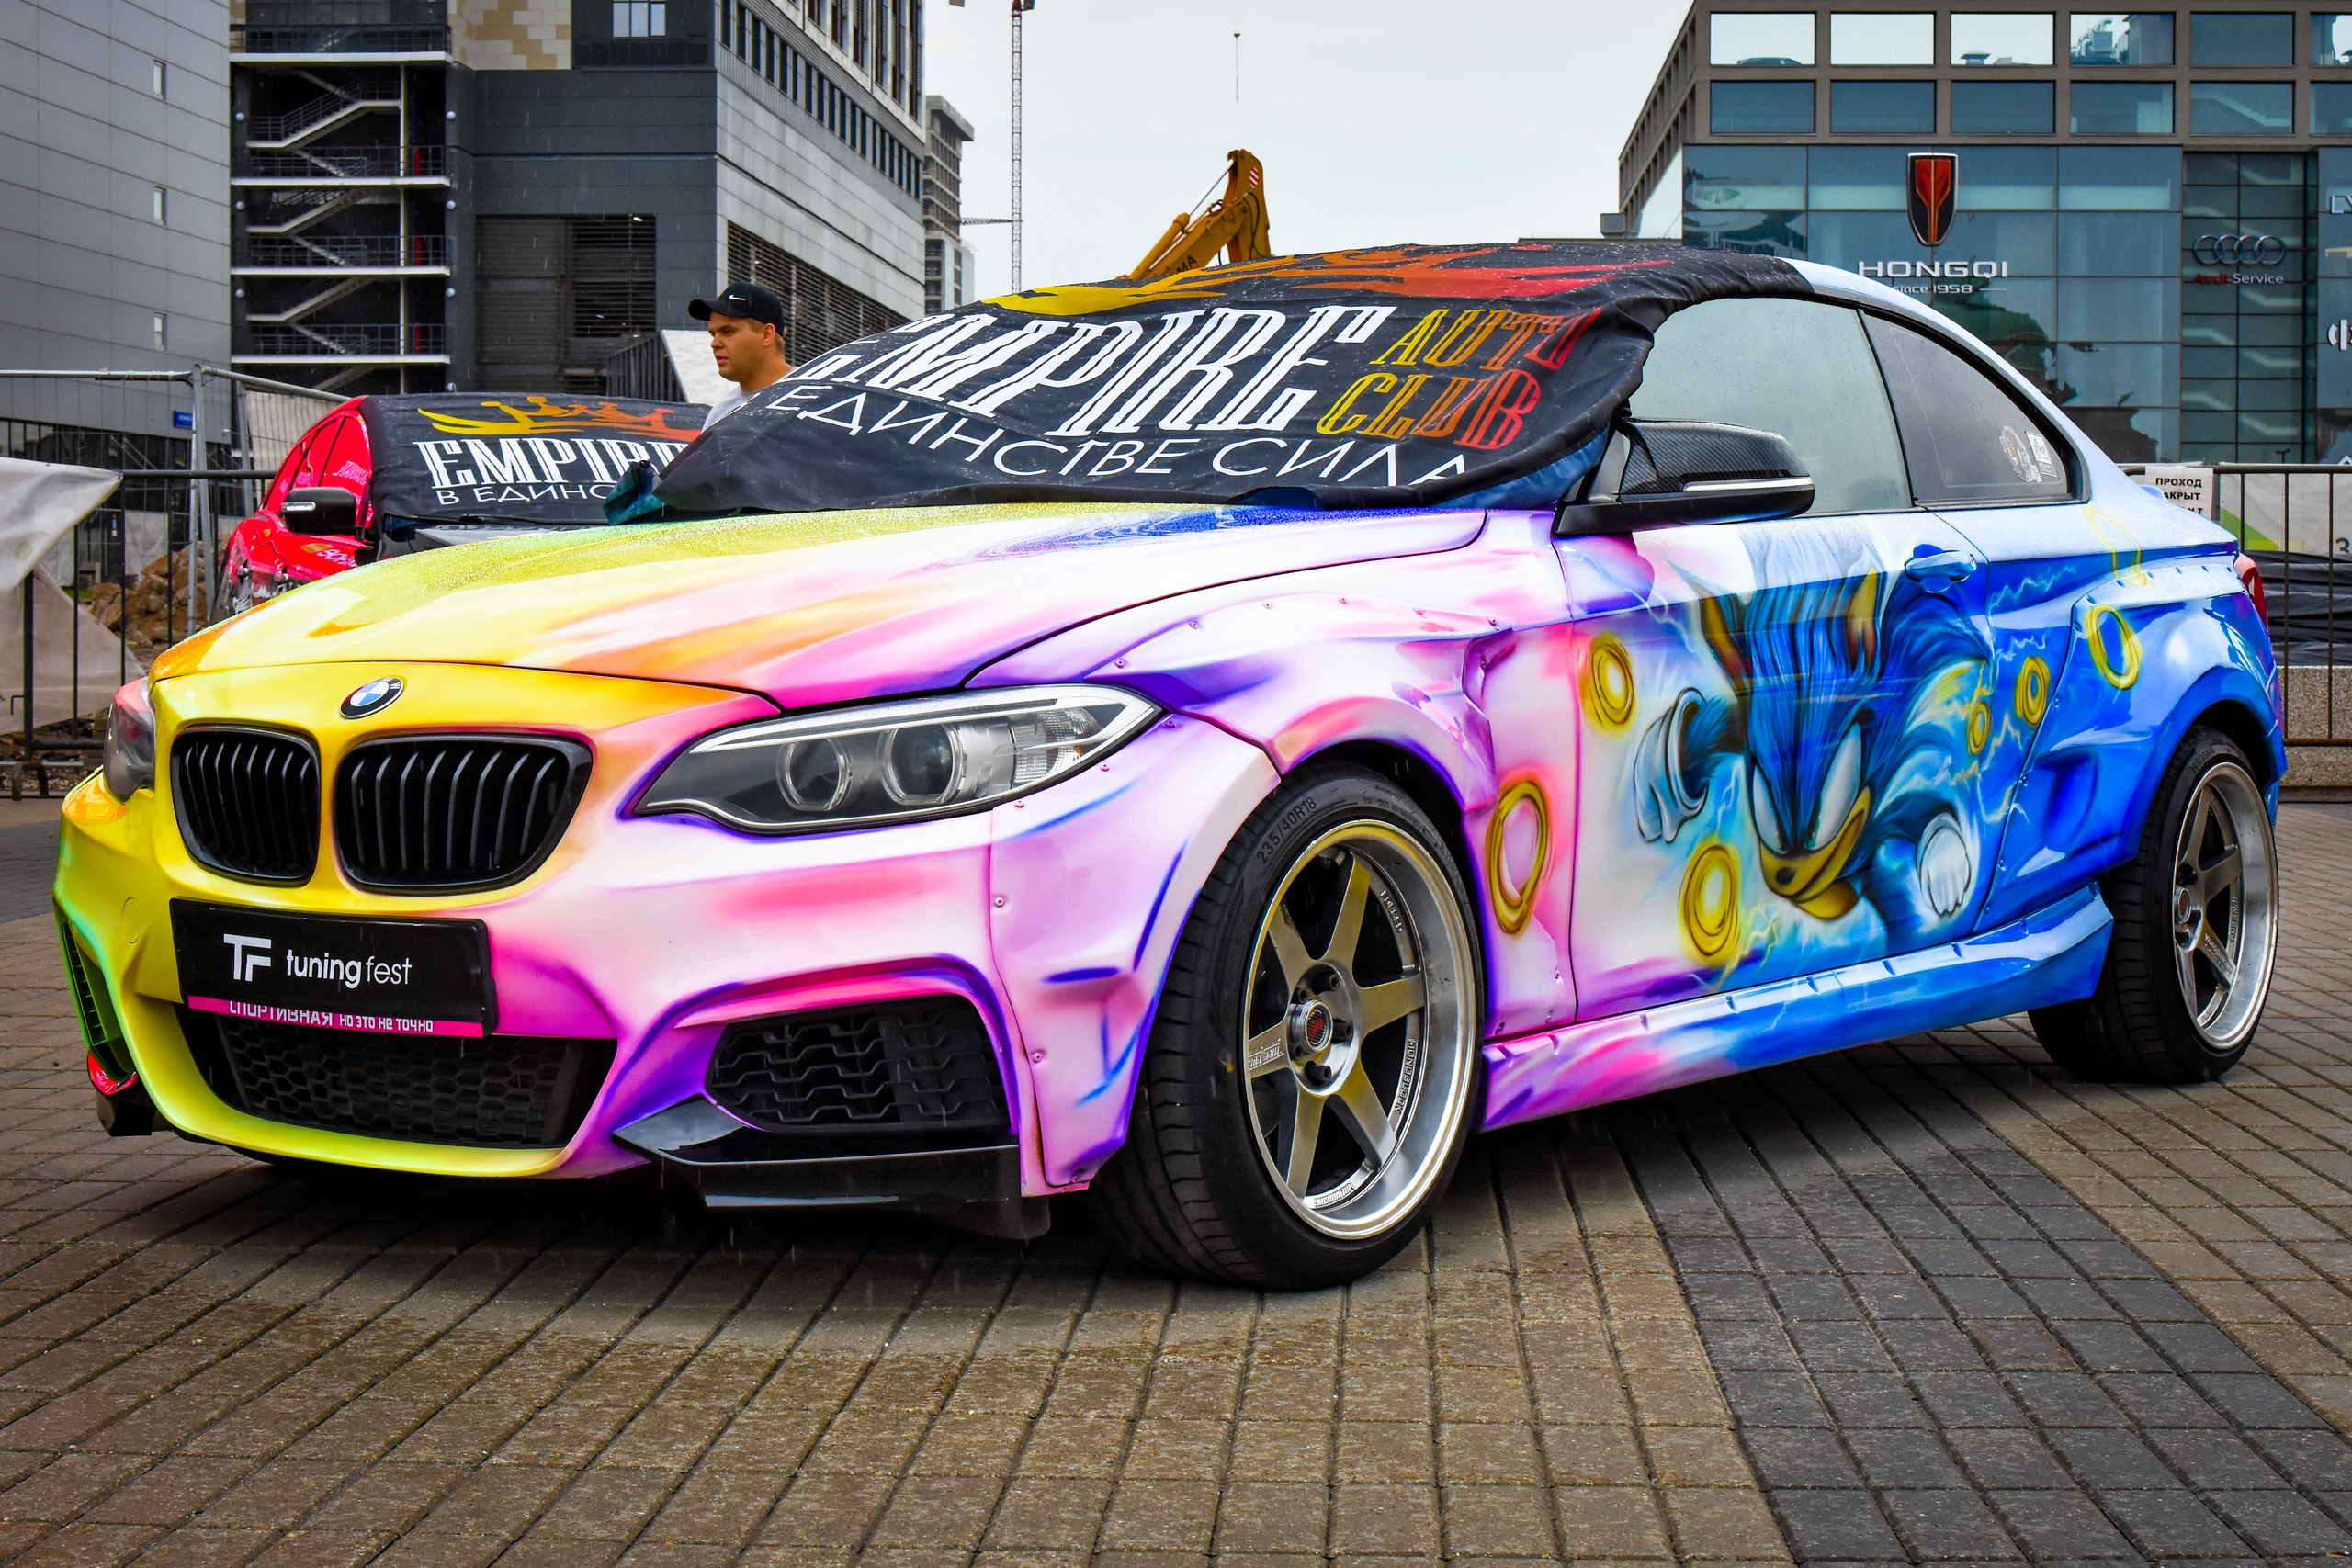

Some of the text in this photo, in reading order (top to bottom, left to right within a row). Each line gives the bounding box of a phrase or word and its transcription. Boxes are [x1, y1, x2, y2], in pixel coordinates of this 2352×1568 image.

[1858, 261, 2007, 278] HONGQI
[2194, 273, 2284, 284] Audi Service
[1933, 284, 1973, 294] 1958
[1316, 369, 1542, 450] CLUB
[765, 384, 1189, 477] ЕДИНСТВЕ
[2155, 477, 2202, 489] ПРОХОД
[436, 490, 459, 505] В
[2163, 491, 2200, 502] АКРЫТ
[1256, 796, 1317, 864] 235/40R18
[1395, 1038, 1417, 1115] MONOBLOCK
